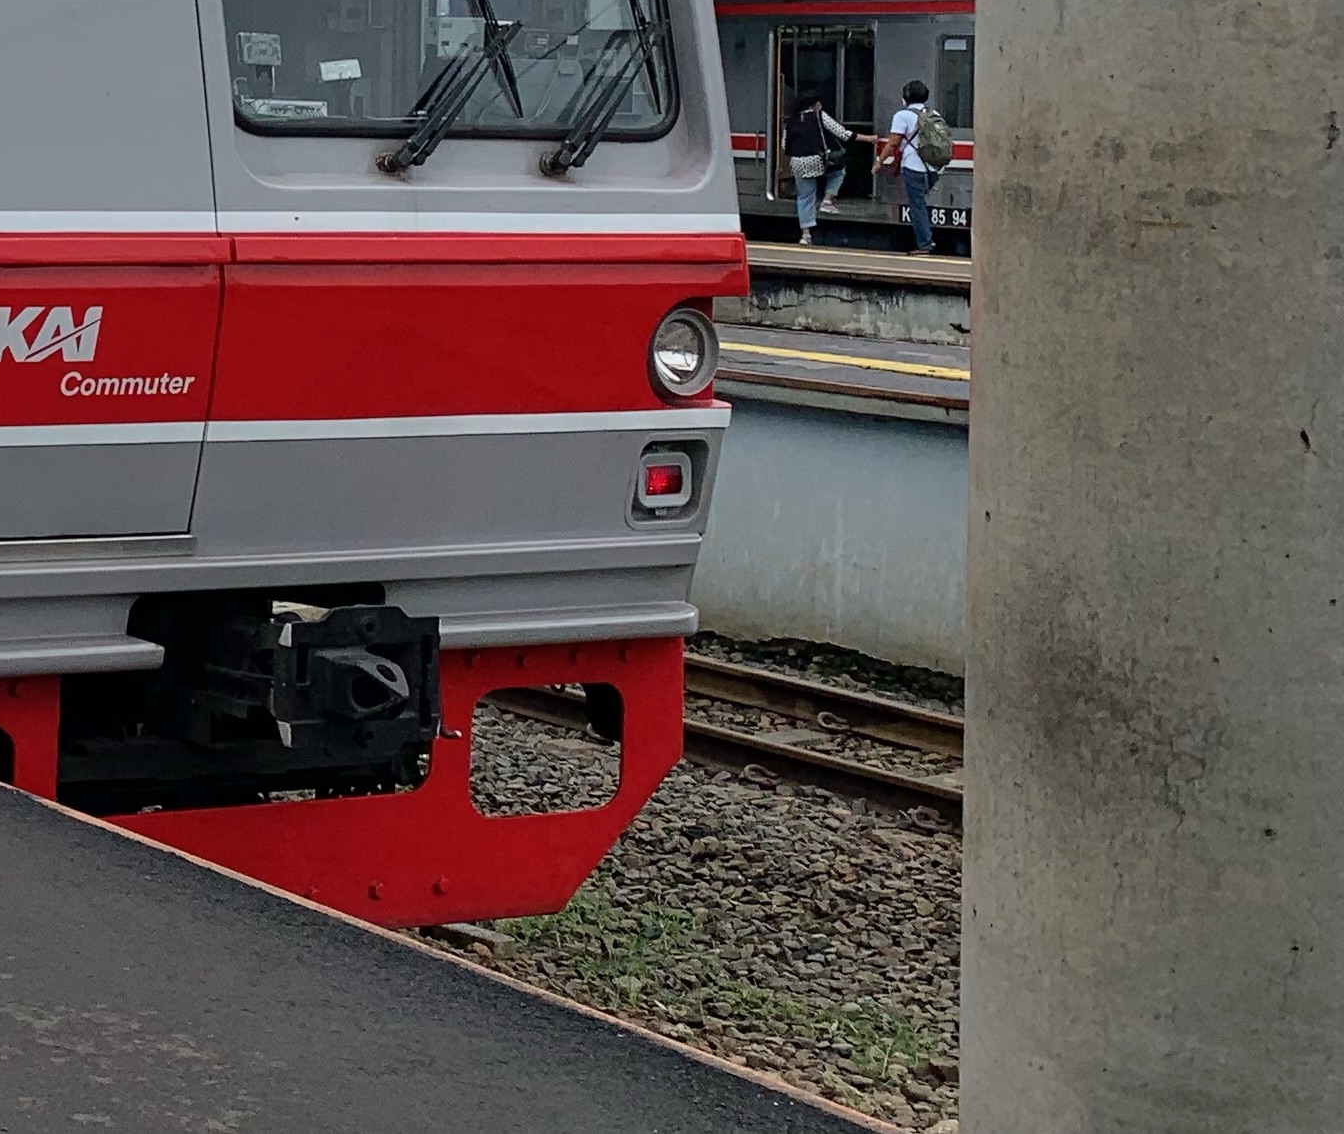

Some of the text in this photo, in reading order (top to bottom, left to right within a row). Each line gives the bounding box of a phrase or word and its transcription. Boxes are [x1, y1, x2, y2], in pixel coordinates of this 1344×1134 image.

[931, 208, 946, 225] 85
[952, 210, 967, 226] 94
[60, 371, 195, 397] Commuter
